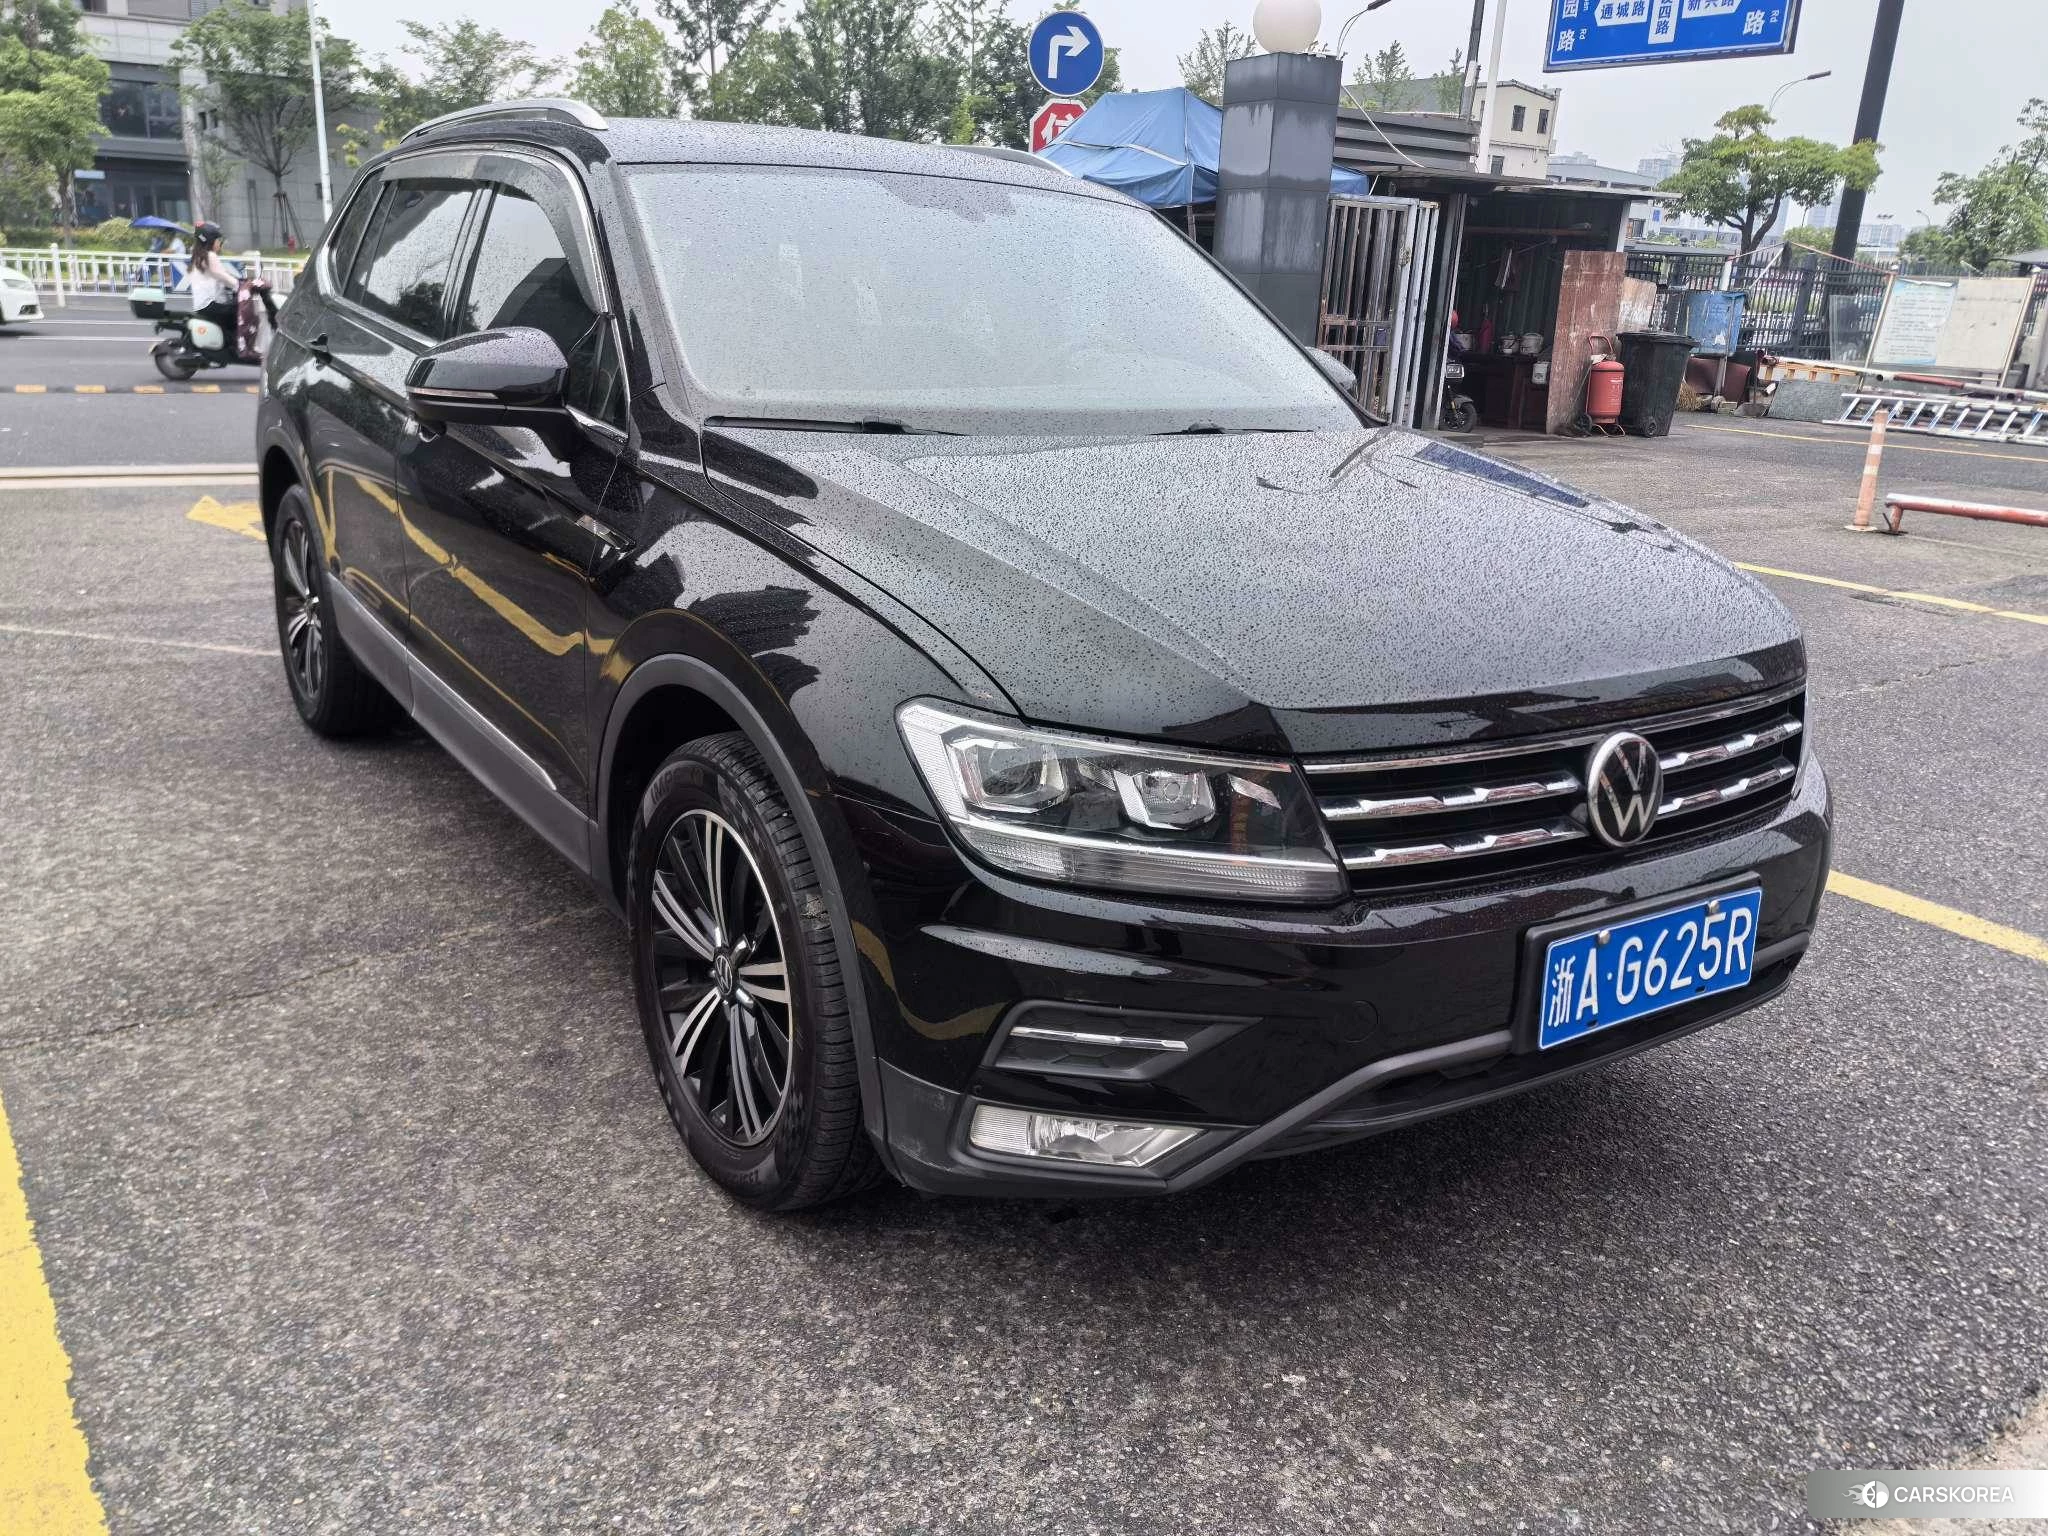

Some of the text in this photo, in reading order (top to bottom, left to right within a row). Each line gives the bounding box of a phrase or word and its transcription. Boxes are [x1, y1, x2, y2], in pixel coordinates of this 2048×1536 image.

[1600, 1, 1646, 19] 通城路
[1656, 0, 1673, 35] 四路
[1743, 10, 1766, 36] 路
